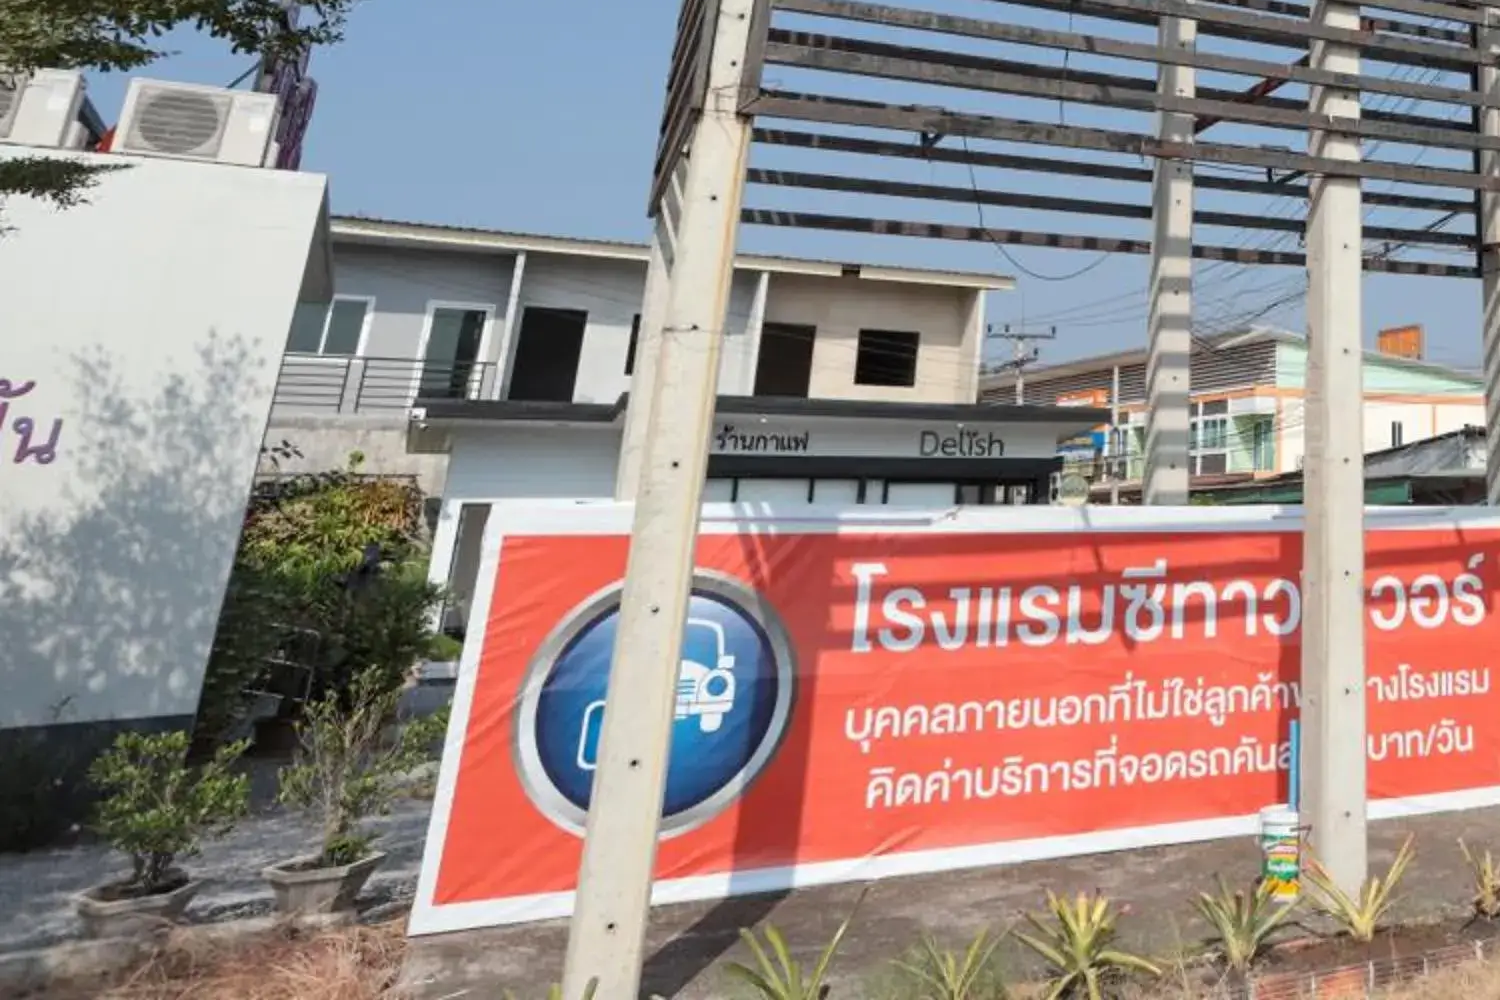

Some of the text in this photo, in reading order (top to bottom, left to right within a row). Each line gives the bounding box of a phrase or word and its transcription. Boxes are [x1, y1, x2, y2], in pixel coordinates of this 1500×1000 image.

[715, 424, 1005, 457] ร้านกาแฟ Delish
